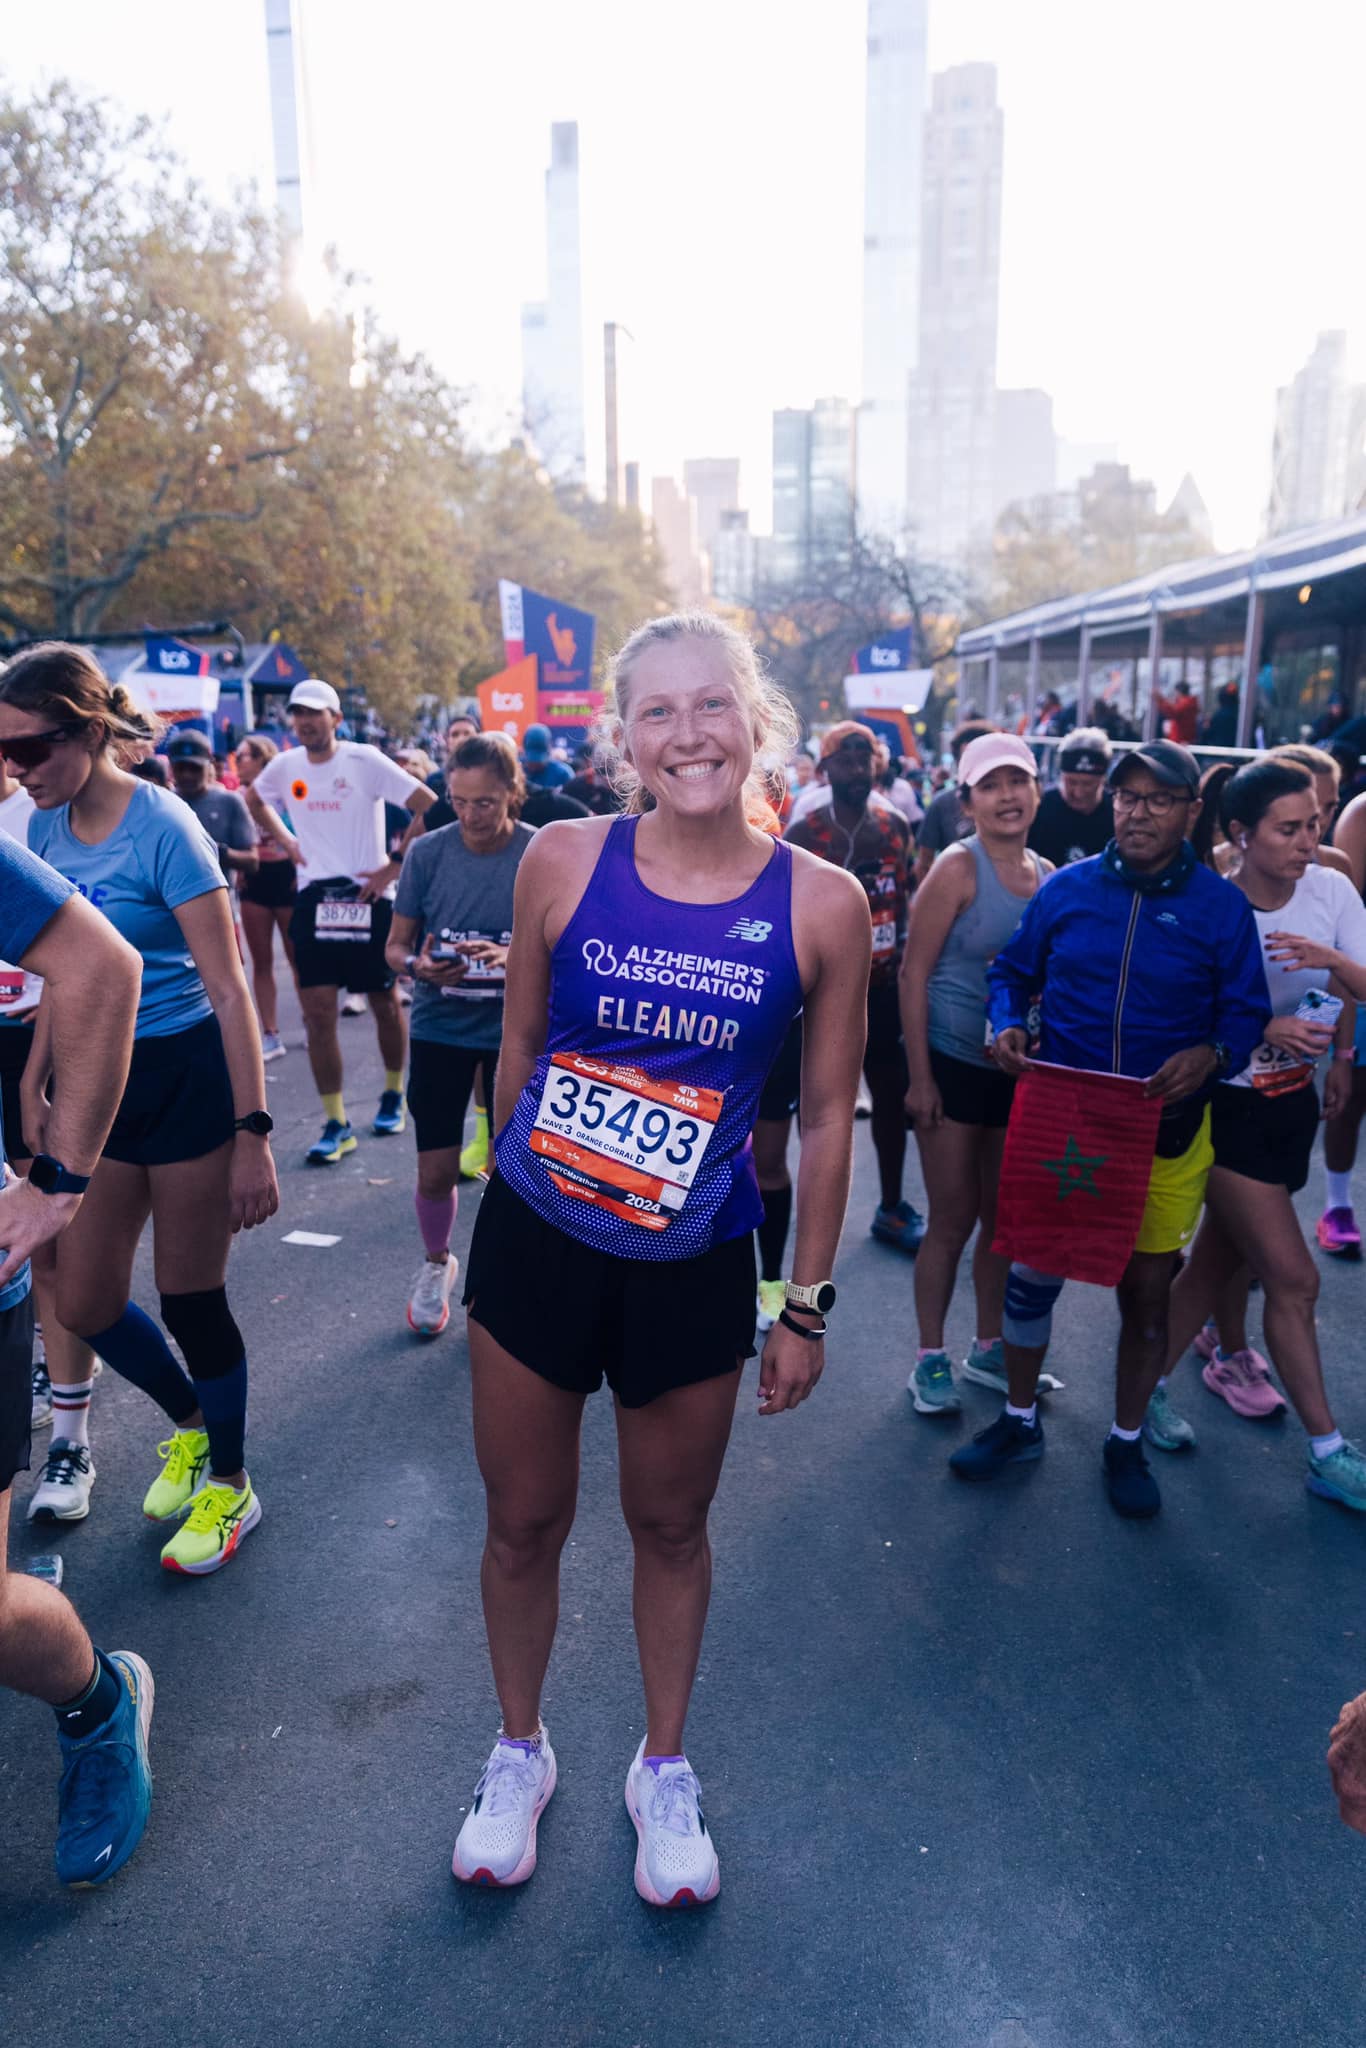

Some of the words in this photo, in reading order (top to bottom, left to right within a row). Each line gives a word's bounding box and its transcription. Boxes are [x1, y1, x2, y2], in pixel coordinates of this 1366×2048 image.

[159, 648, 191, 670] tcs
[491, 688, 524, 712] tcs
[615, 962, 762, 1005] ASSOCIATION
[625, 945, 765, 986] ALZHEIMER'S
[597, 995, 740, 1052] ELEANOR
[549, 1075, 699, 1165] 35493
[673, 1093, 698, 1110] TATA
[541, 1117, 564, 1131] WAVE
[564, 1124, 573, 1135] 3
[576, 1131, 603, 1148] ORANGE
[603, 1143, 634, 1161] CORRAL
[635, 1154, 645, 1165] D
[540, 1157, 599, 1190] #TCSNYCMarathon
[624, 1193, 661, 1214] 2024
